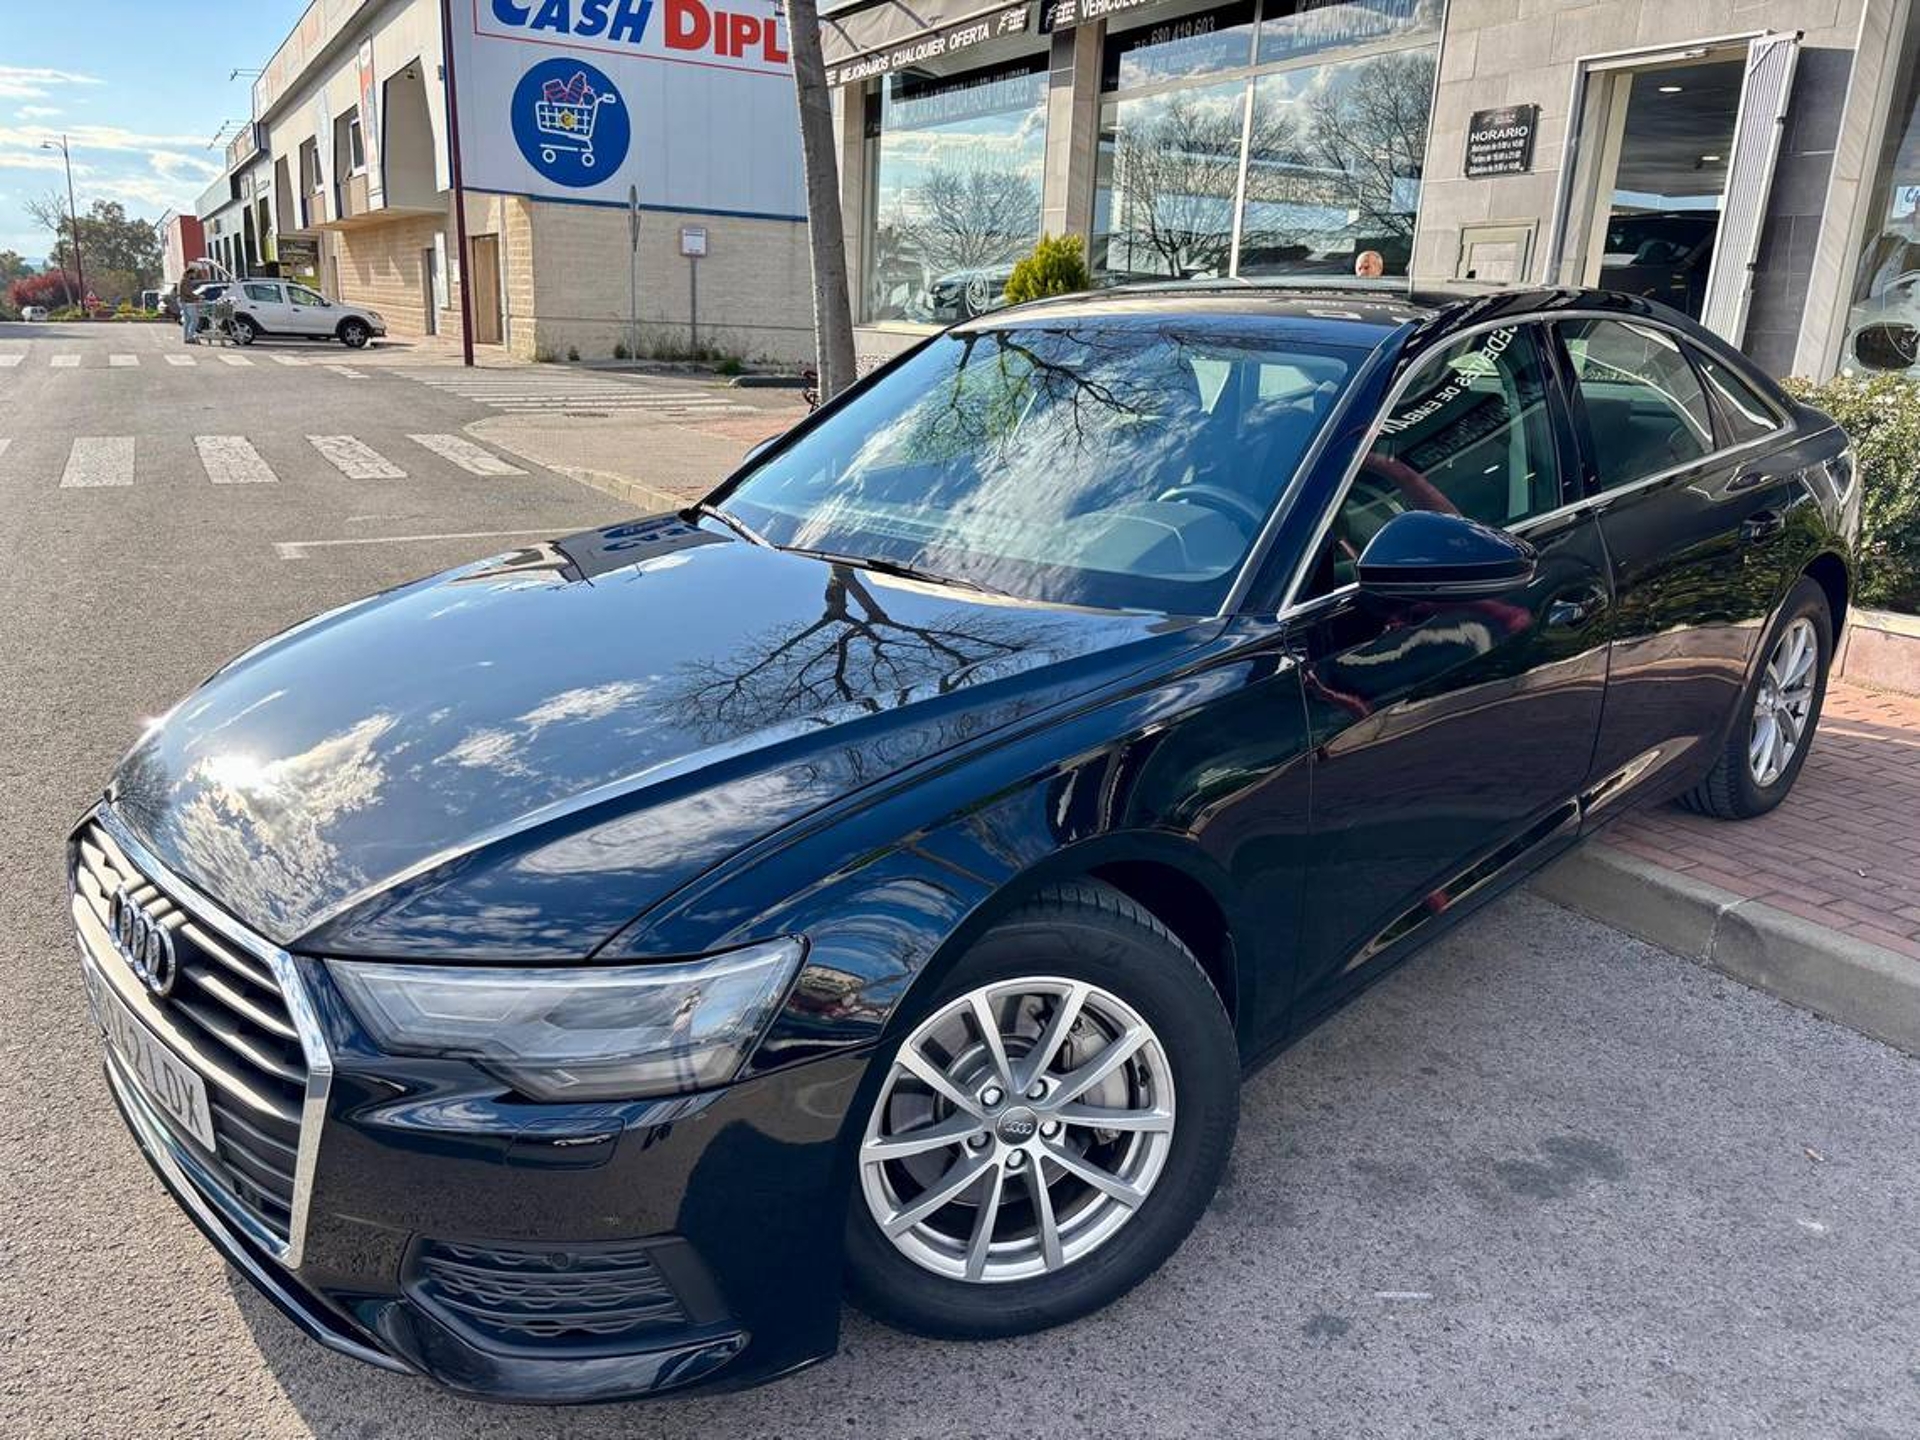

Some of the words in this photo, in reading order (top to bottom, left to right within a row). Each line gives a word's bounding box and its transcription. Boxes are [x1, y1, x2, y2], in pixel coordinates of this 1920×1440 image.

[491, 0, 653, 44] CASH
[1081, 0, 1146, 18] VEHIC
[840, 55, 890, 83] MEJORAMOS
[892, 39, 946, 66] CUALQUIER
[949, 23, 990, 49] OFERTA
[1470, 125, 1529, 143] HORARIO
[147, 1042, 204, 1138] LDX
